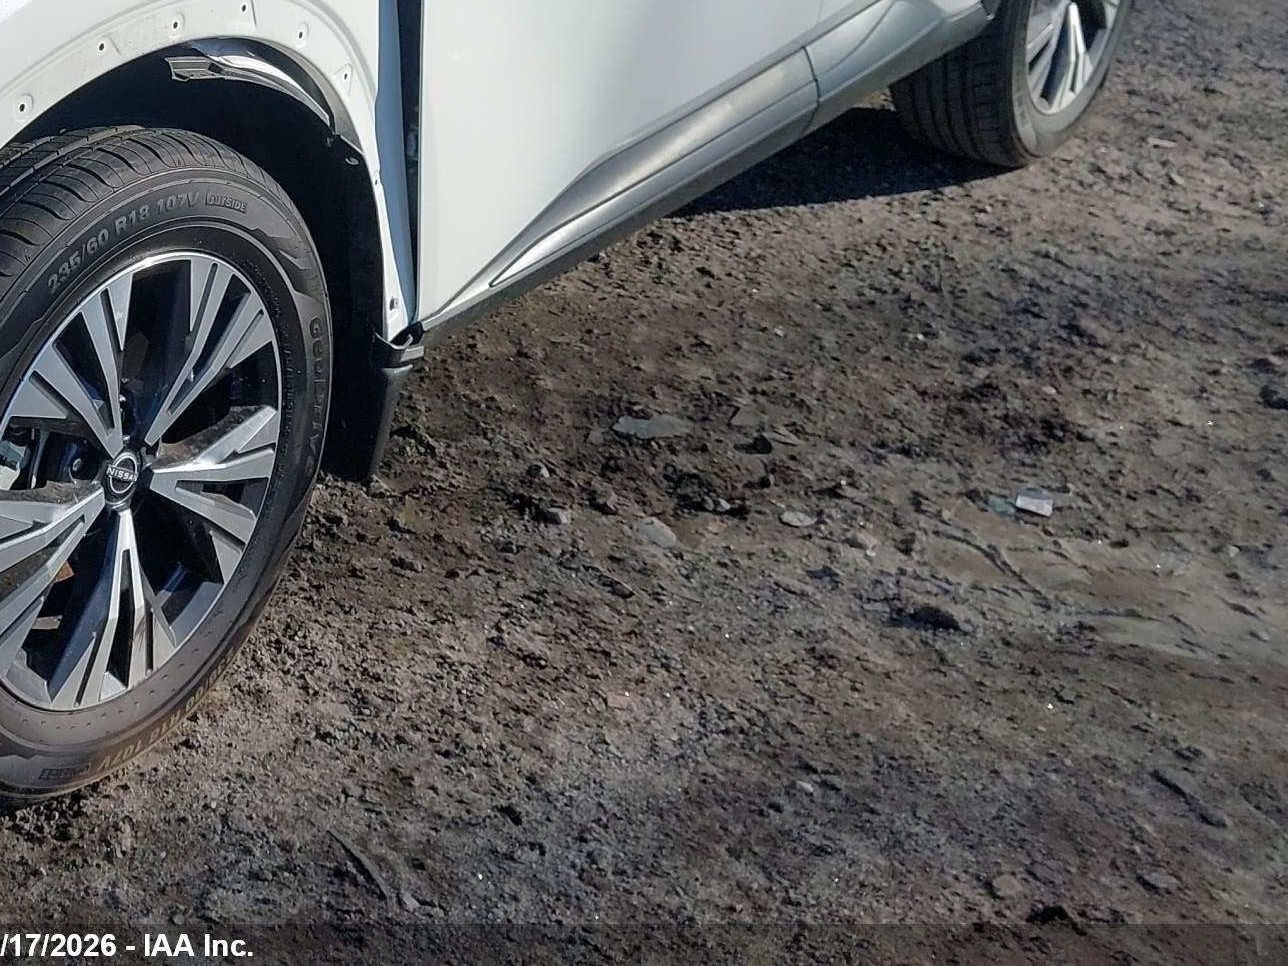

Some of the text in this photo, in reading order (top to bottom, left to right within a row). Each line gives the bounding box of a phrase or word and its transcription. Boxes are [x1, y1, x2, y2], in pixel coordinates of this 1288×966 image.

[47, 229, 110, 293] 235/60
[114, 204, 151, 235] R18
[156, 192, 199, 215] 107V
